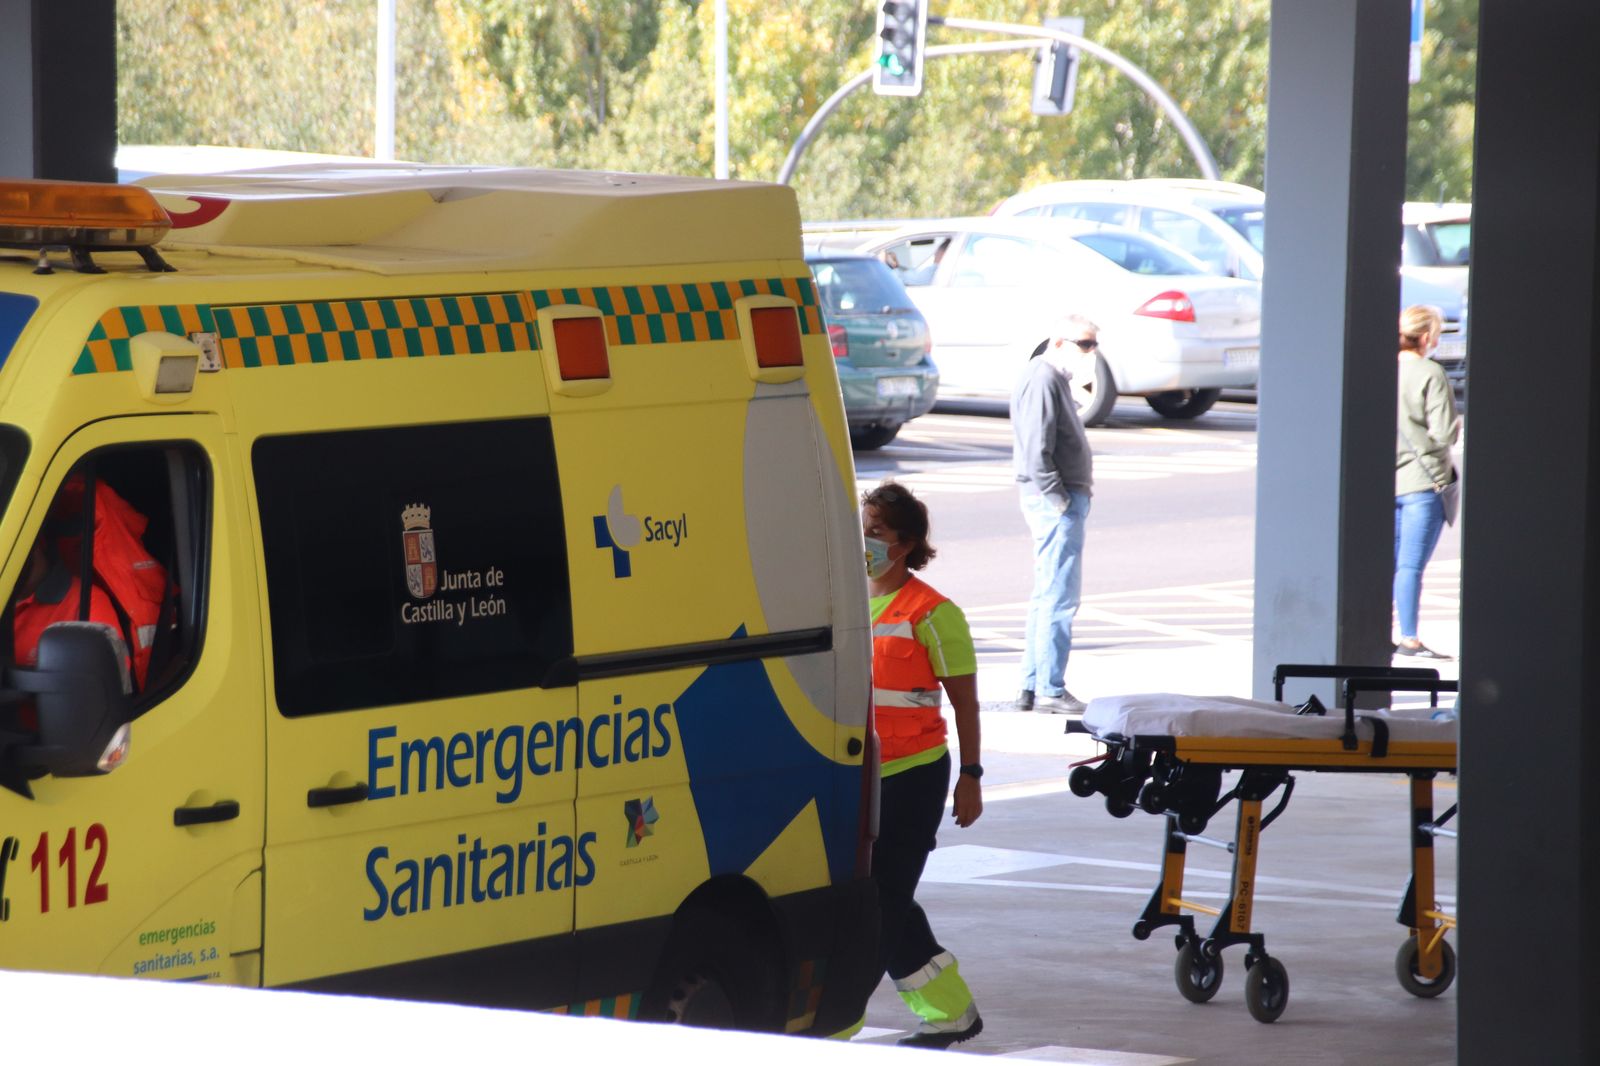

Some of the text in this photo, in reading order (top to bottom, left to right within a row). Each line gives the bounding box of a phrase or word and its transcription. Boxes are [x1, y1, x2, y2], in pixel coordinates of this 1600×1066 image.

[643, 512, 688, 548] Sacyl
[440, 566, 505, 591] Junta de
[401, 593, 506, 626] Castilla y León
[367, 694, 672, 804] Emergencias
[31, 822, 109, 914] 112
[363, 821, 597, 922] Sanitarias
[138, 918, 217, 945] emergencias
[133, 946, 220, 975] sanitarias, s.a.
